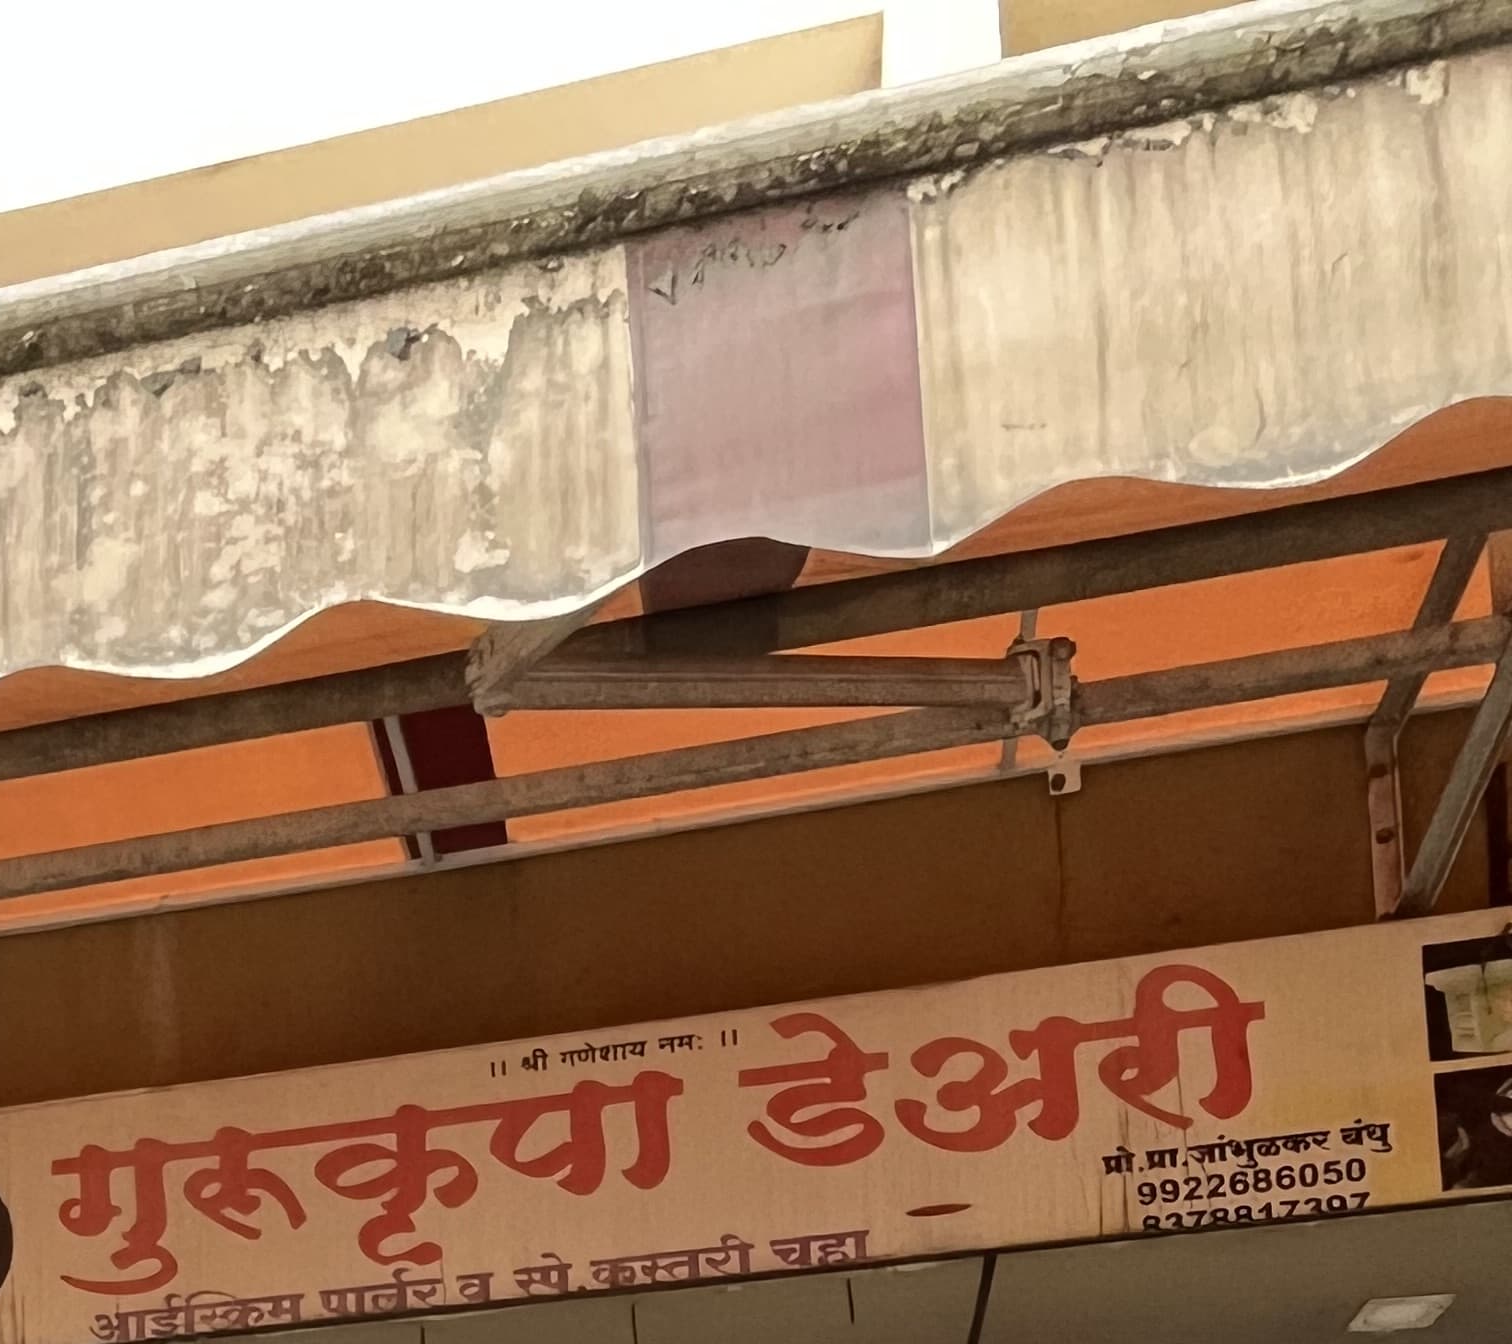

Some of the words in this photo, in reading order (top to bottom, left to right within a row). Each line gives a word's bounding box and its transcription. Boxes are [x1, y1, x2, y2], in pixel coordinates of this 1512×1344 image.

[520, 1048, 548, 1071] श्री
[560, 1042, 648, 1067] गणेशाय
[738, 963, 1265, 1167] डेअरी
[1137, 1158, 1367, 1206] 9922686050
[320, 1268, 444, 1316] पार्लर
[457, 1272, 494, 1304] व
